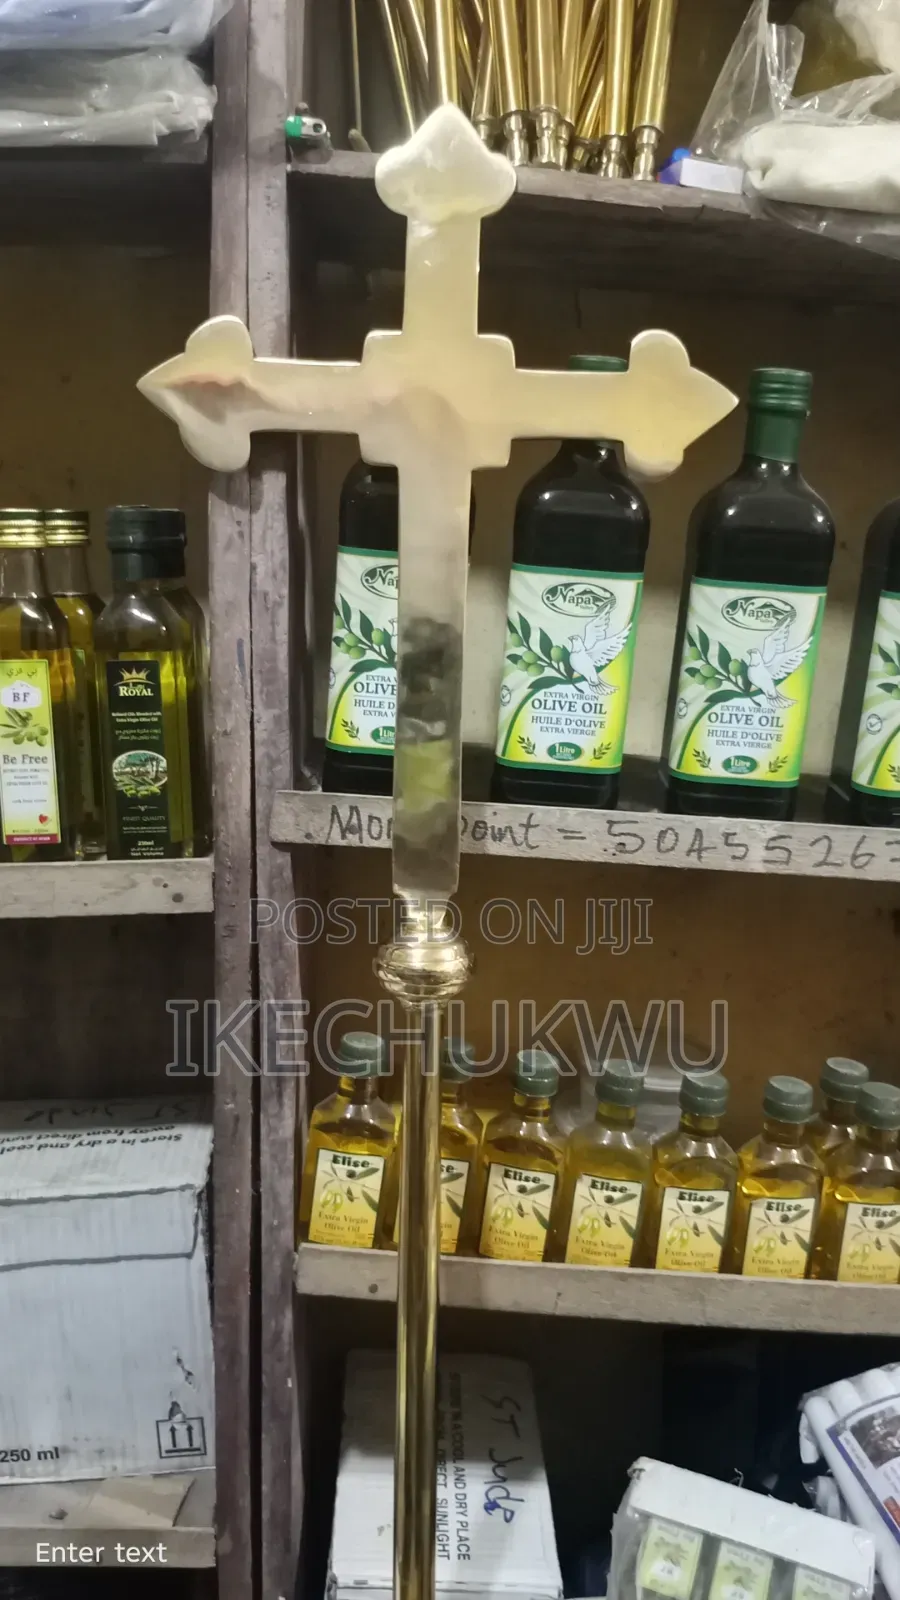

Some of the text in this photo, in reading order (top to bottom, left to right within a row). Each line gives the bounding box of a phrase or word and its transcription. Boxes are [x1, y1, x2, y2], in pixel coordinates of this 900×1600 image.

[546, 587, 591, 606] Napa
[726, 601, 771, 620] Napa
[365, 675, 391, 683] EXTRA
[119, 685, 154, 697] ROYAL
[353, 681, 396, 695] OLIVE
[543, 691, 599, 701] EXTRA VIRGIN
[354, 699, 385, 710] HUILE
[531, 698, 607, 715] OLIVE OIL
[720, 704, 776, 715] EXTRA VIRGIN
[362, 710, 388, 718] EXTRA
[531, 715, 562, 726] HUILE
[707, 712, 784, 728] OLIVE OIL
[540, 726, 596, 737] EXTRA VIERGE
[707, 729, 738, 739] HUILE
[554, 743, 560, 754] 1
[715, 740, 772, 749] EXTRA VIERGE
[3, 754, 48, 765] Be Free
[86, 1129, 124, 1137] from
[140, 1133, 182, 1144] Store
[37, 1142, 70, 1151] and
[74, 1139, 102, 1148] dry
[121, 1138, 136, 1146] in
[332, 1153, 370, 1168] Elise
[503, 1168, 541, 1184] Elise
[590, 1179, 628, 1193] Elise
[678, 1191, 715, 1202] Elise
[766, 1201, 802, 1213] Elise
[861, 1207, 897, 1218] Elise
[319, 1211, 369, 1225] Extra Virgin
[0, 1446, 60, 1463] 250 ml
[453, 1465, 467, 1490] AND
[455, 1493, 469, 1518] DRY
[436, 1498, 451, 1561] SUNLIGHT
[456, 1520, 471, 1561] PLACE
